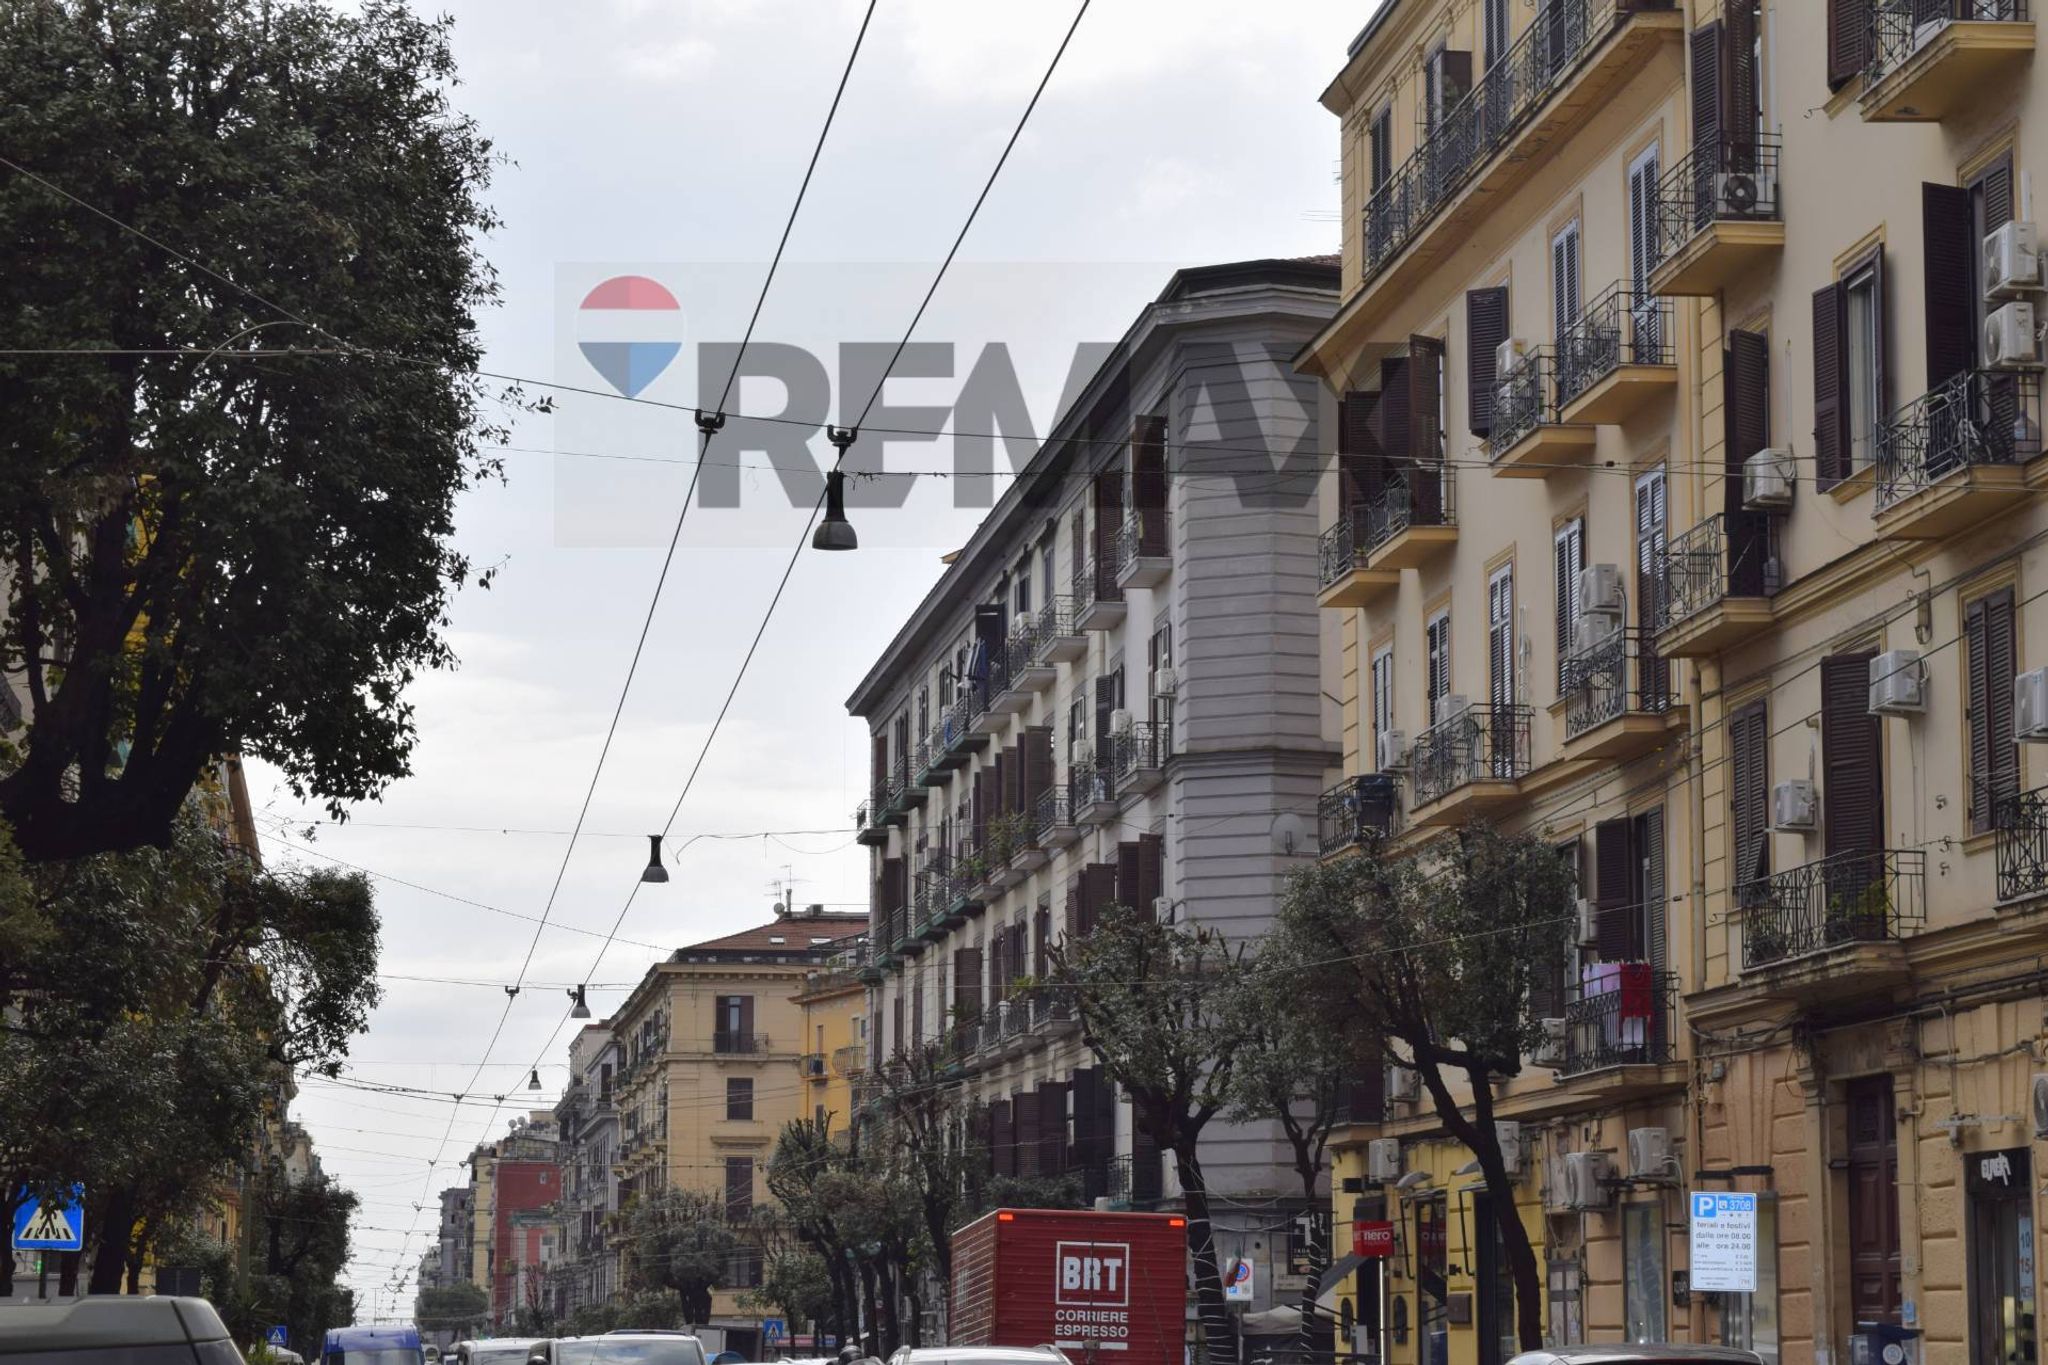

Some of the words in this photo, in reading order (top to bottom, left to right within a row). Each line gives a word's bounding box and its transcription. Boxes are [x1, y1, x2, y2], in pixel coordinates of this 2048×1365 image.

[1699, 1197, 1714, 1216] P
[1729, 1200, 1752, 1211] 3708
[1363, 1230, 1391, 1241] nero
[1695, 1231, 1715, 1239] dalle
[1063, 1256, 1122, 1292] BRT
[1055, 1309, 1129, 1323] CORRIERE
[1055, 1324, 1129, 1338] ESPRESSO
